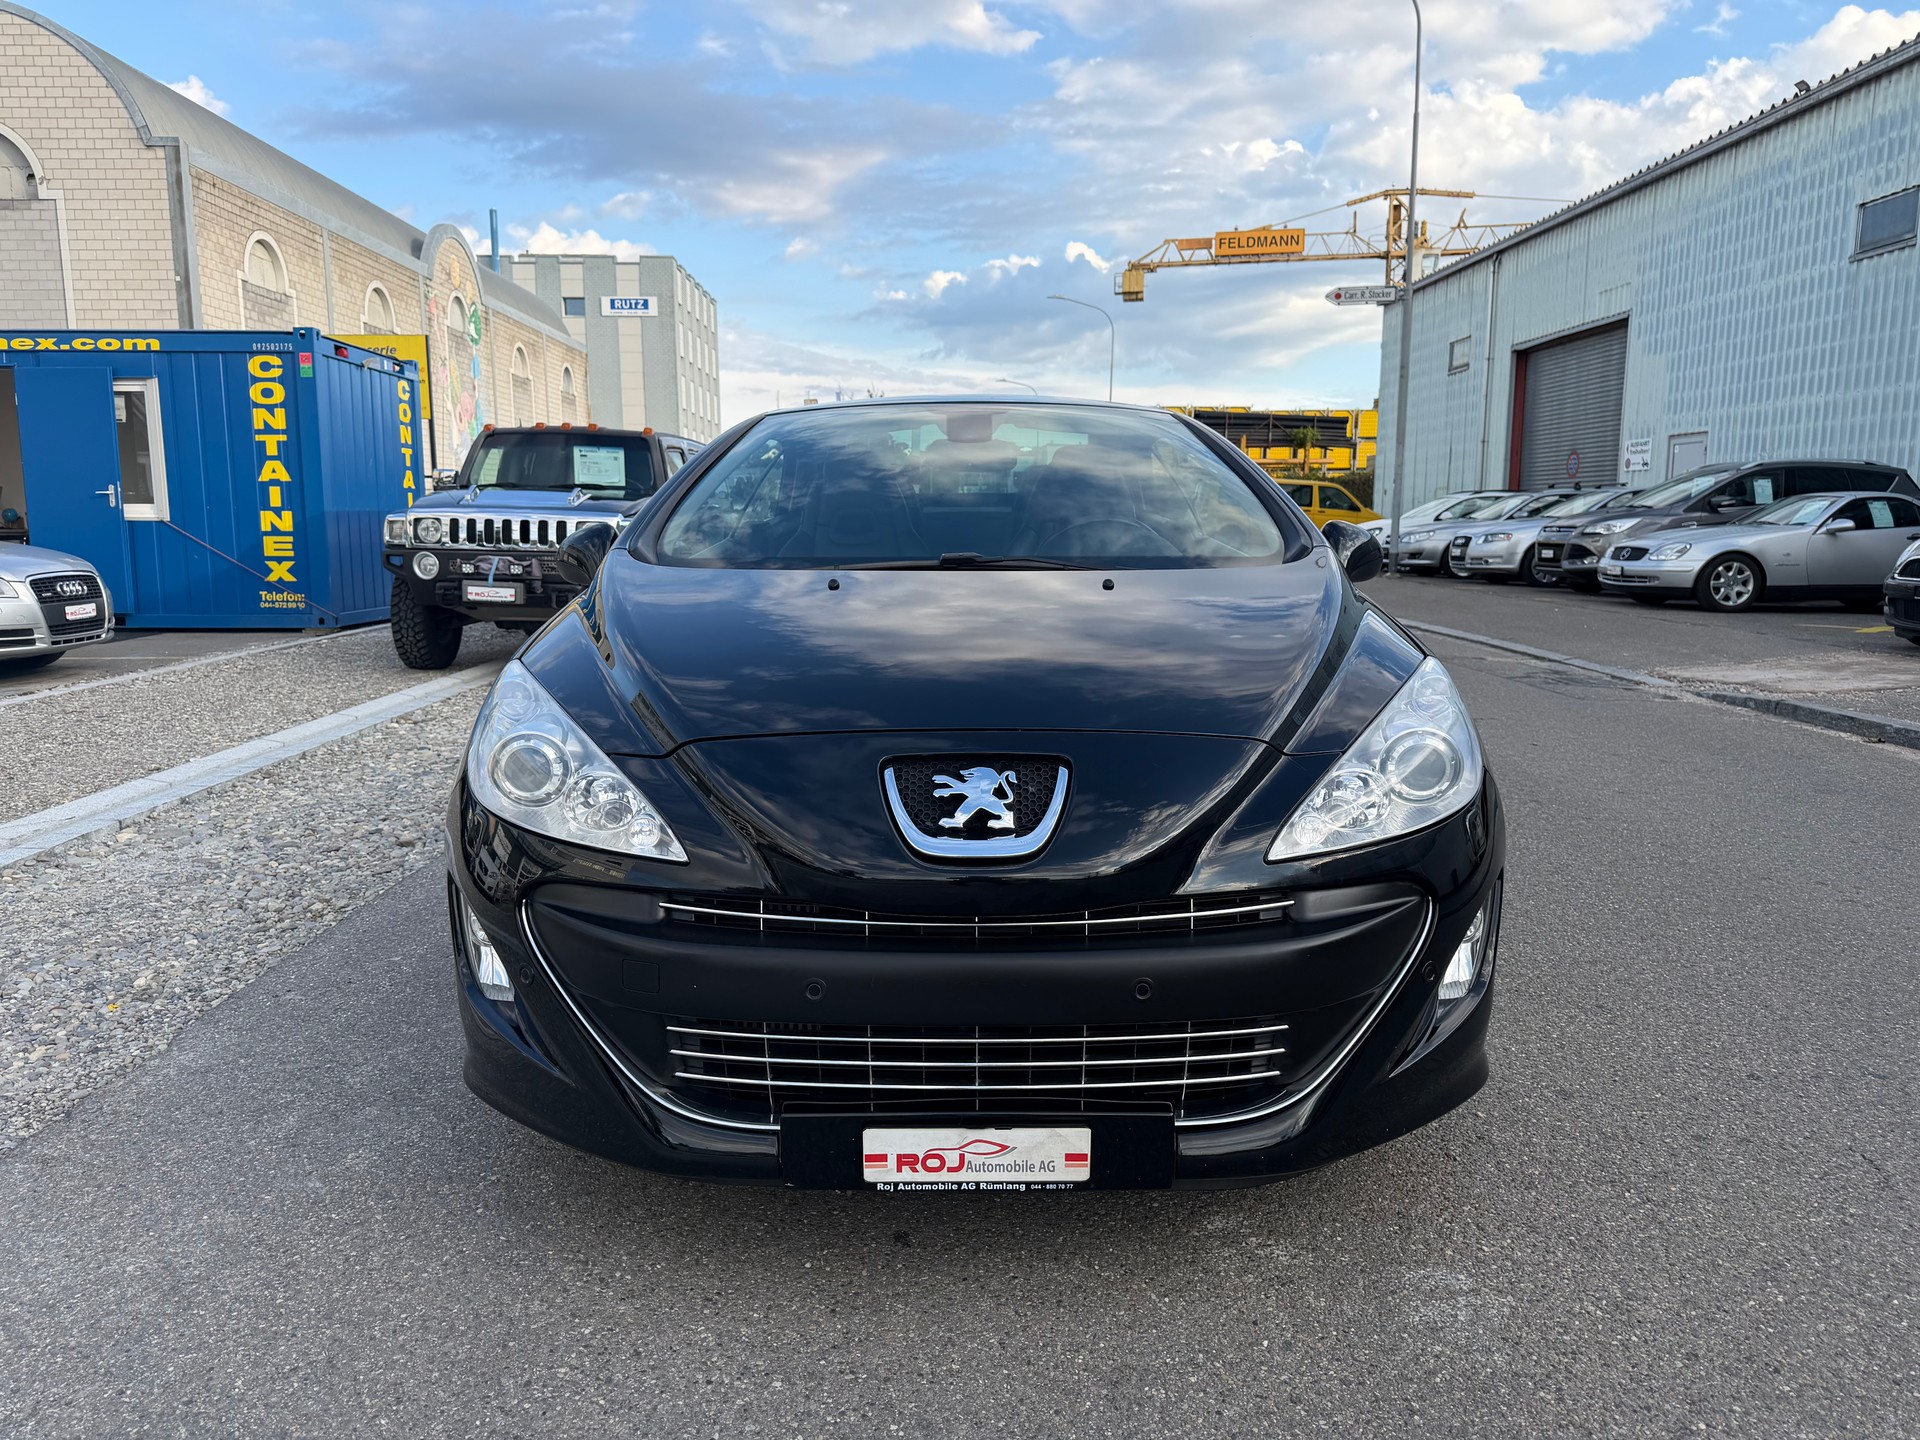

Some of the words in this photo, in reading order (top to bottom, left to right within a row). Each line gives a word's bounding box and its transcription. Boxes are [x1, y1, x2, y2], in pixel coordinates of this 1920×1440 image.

[1219, 234, 1300, 249] FELDMANN
[1361, 290, 1367, 299] R.
[1368, 289, 1392, 299] Stocker
[614, 299, 645, 309] RUTZ
[252, 343, 293, 351] 092503175
[247, 354, 298, 582] CONTAINEX
[259, 590, 305, 602] Telefon:
[896, 1153, 966, 1174] ROJ
[965, 1159, 1036, 1173] Automobile
[1038, 1160, 1056, 1173] AG
[877, 1182, 894, 1192] Roj
[897, 1182, 958, 1190] Automobile
[961, 1182, 976, 1190] AG
[980, 1182, 1026, 1191] Rümlang
